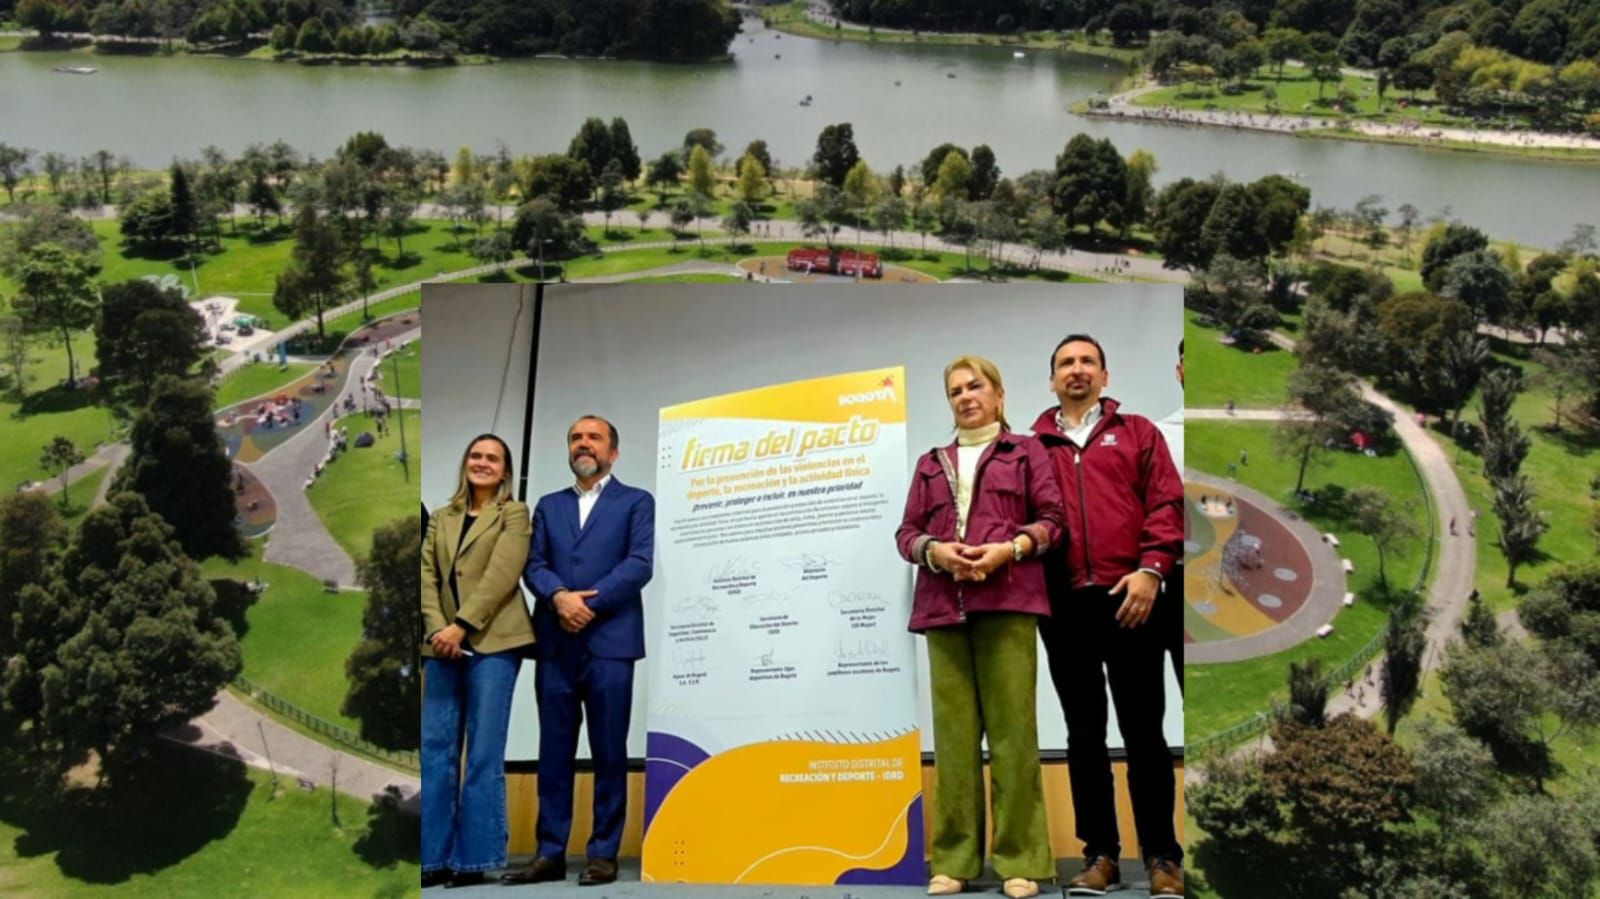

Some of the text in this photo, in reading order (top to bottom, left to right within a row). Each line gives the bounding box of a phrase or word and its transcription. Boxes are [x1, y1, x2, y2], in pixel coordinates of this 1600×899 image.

[681, 416, 879, 470] firma del pacto
[767, 465, 778, 476] de
[780, 463, 792, 475] las
[843, 456, 855, 466] en
[857, 453, 866, 463] el
